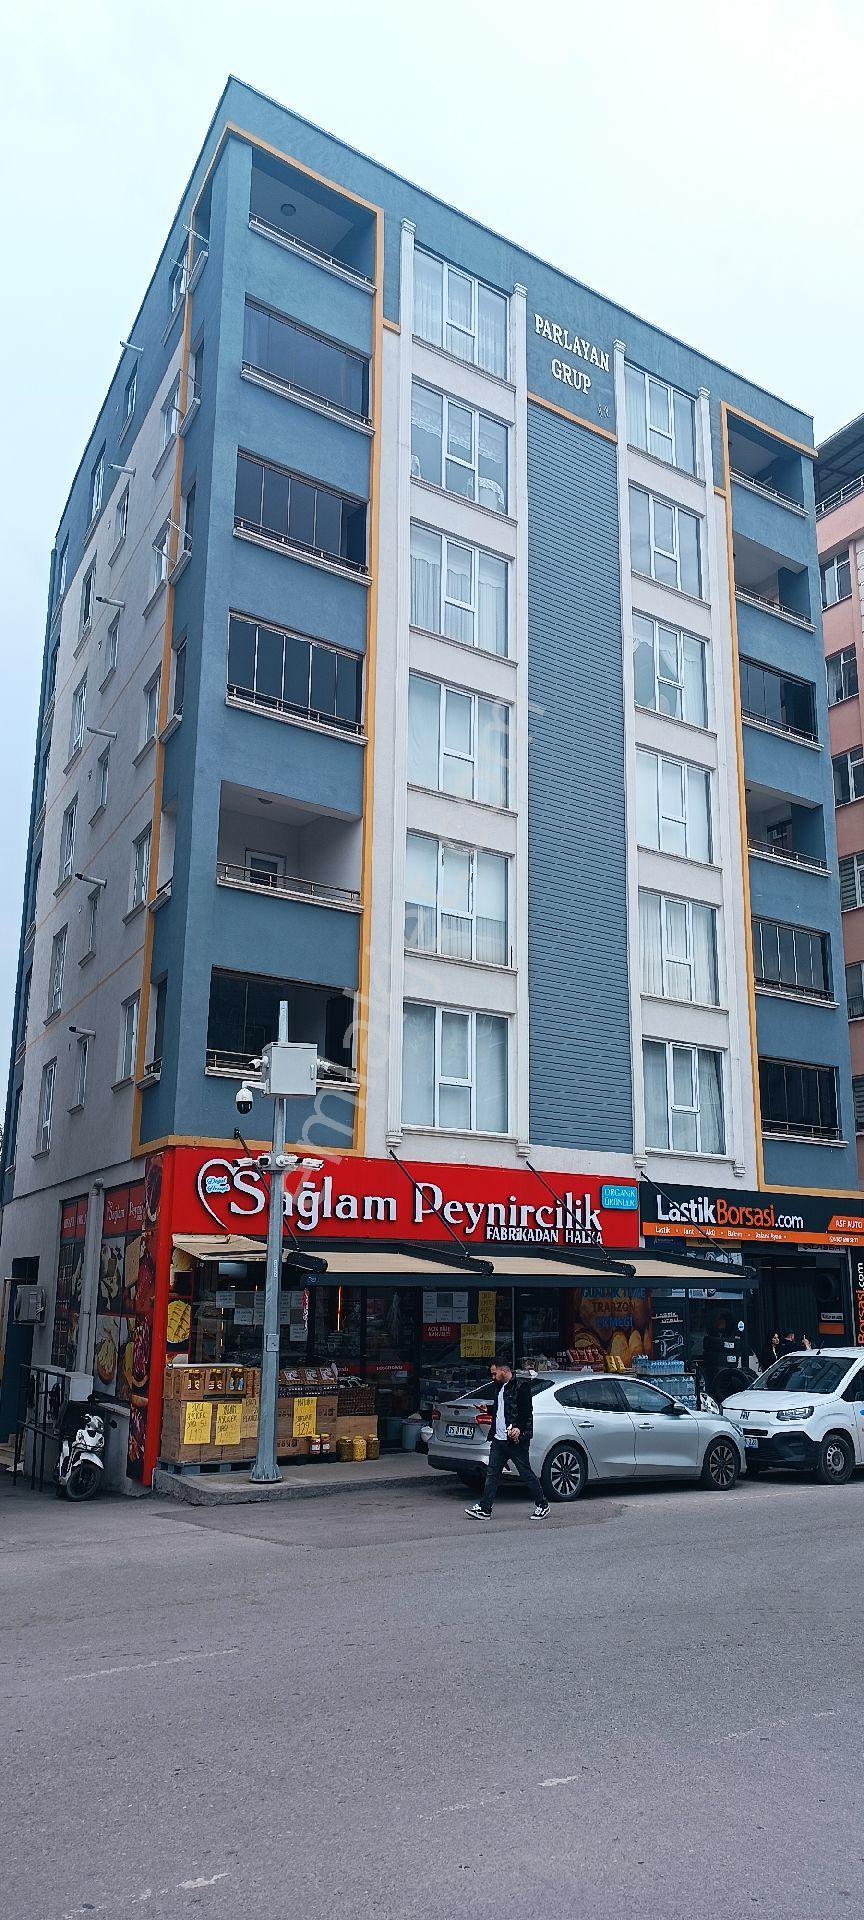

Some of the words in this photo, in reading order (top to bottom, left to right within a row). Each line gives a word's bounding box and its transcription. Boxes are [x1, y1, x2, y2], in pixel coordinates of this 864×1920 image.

[534, 313, 610, 373] PARLAYAN
[551, 358, 592, 395] GRUP
[413, 1182, 603, 1234] Peynircilik
[656, 1194, 804, 1230] LastikBorsasi.com
[592, 1301, 636, 1312] TRABZON
